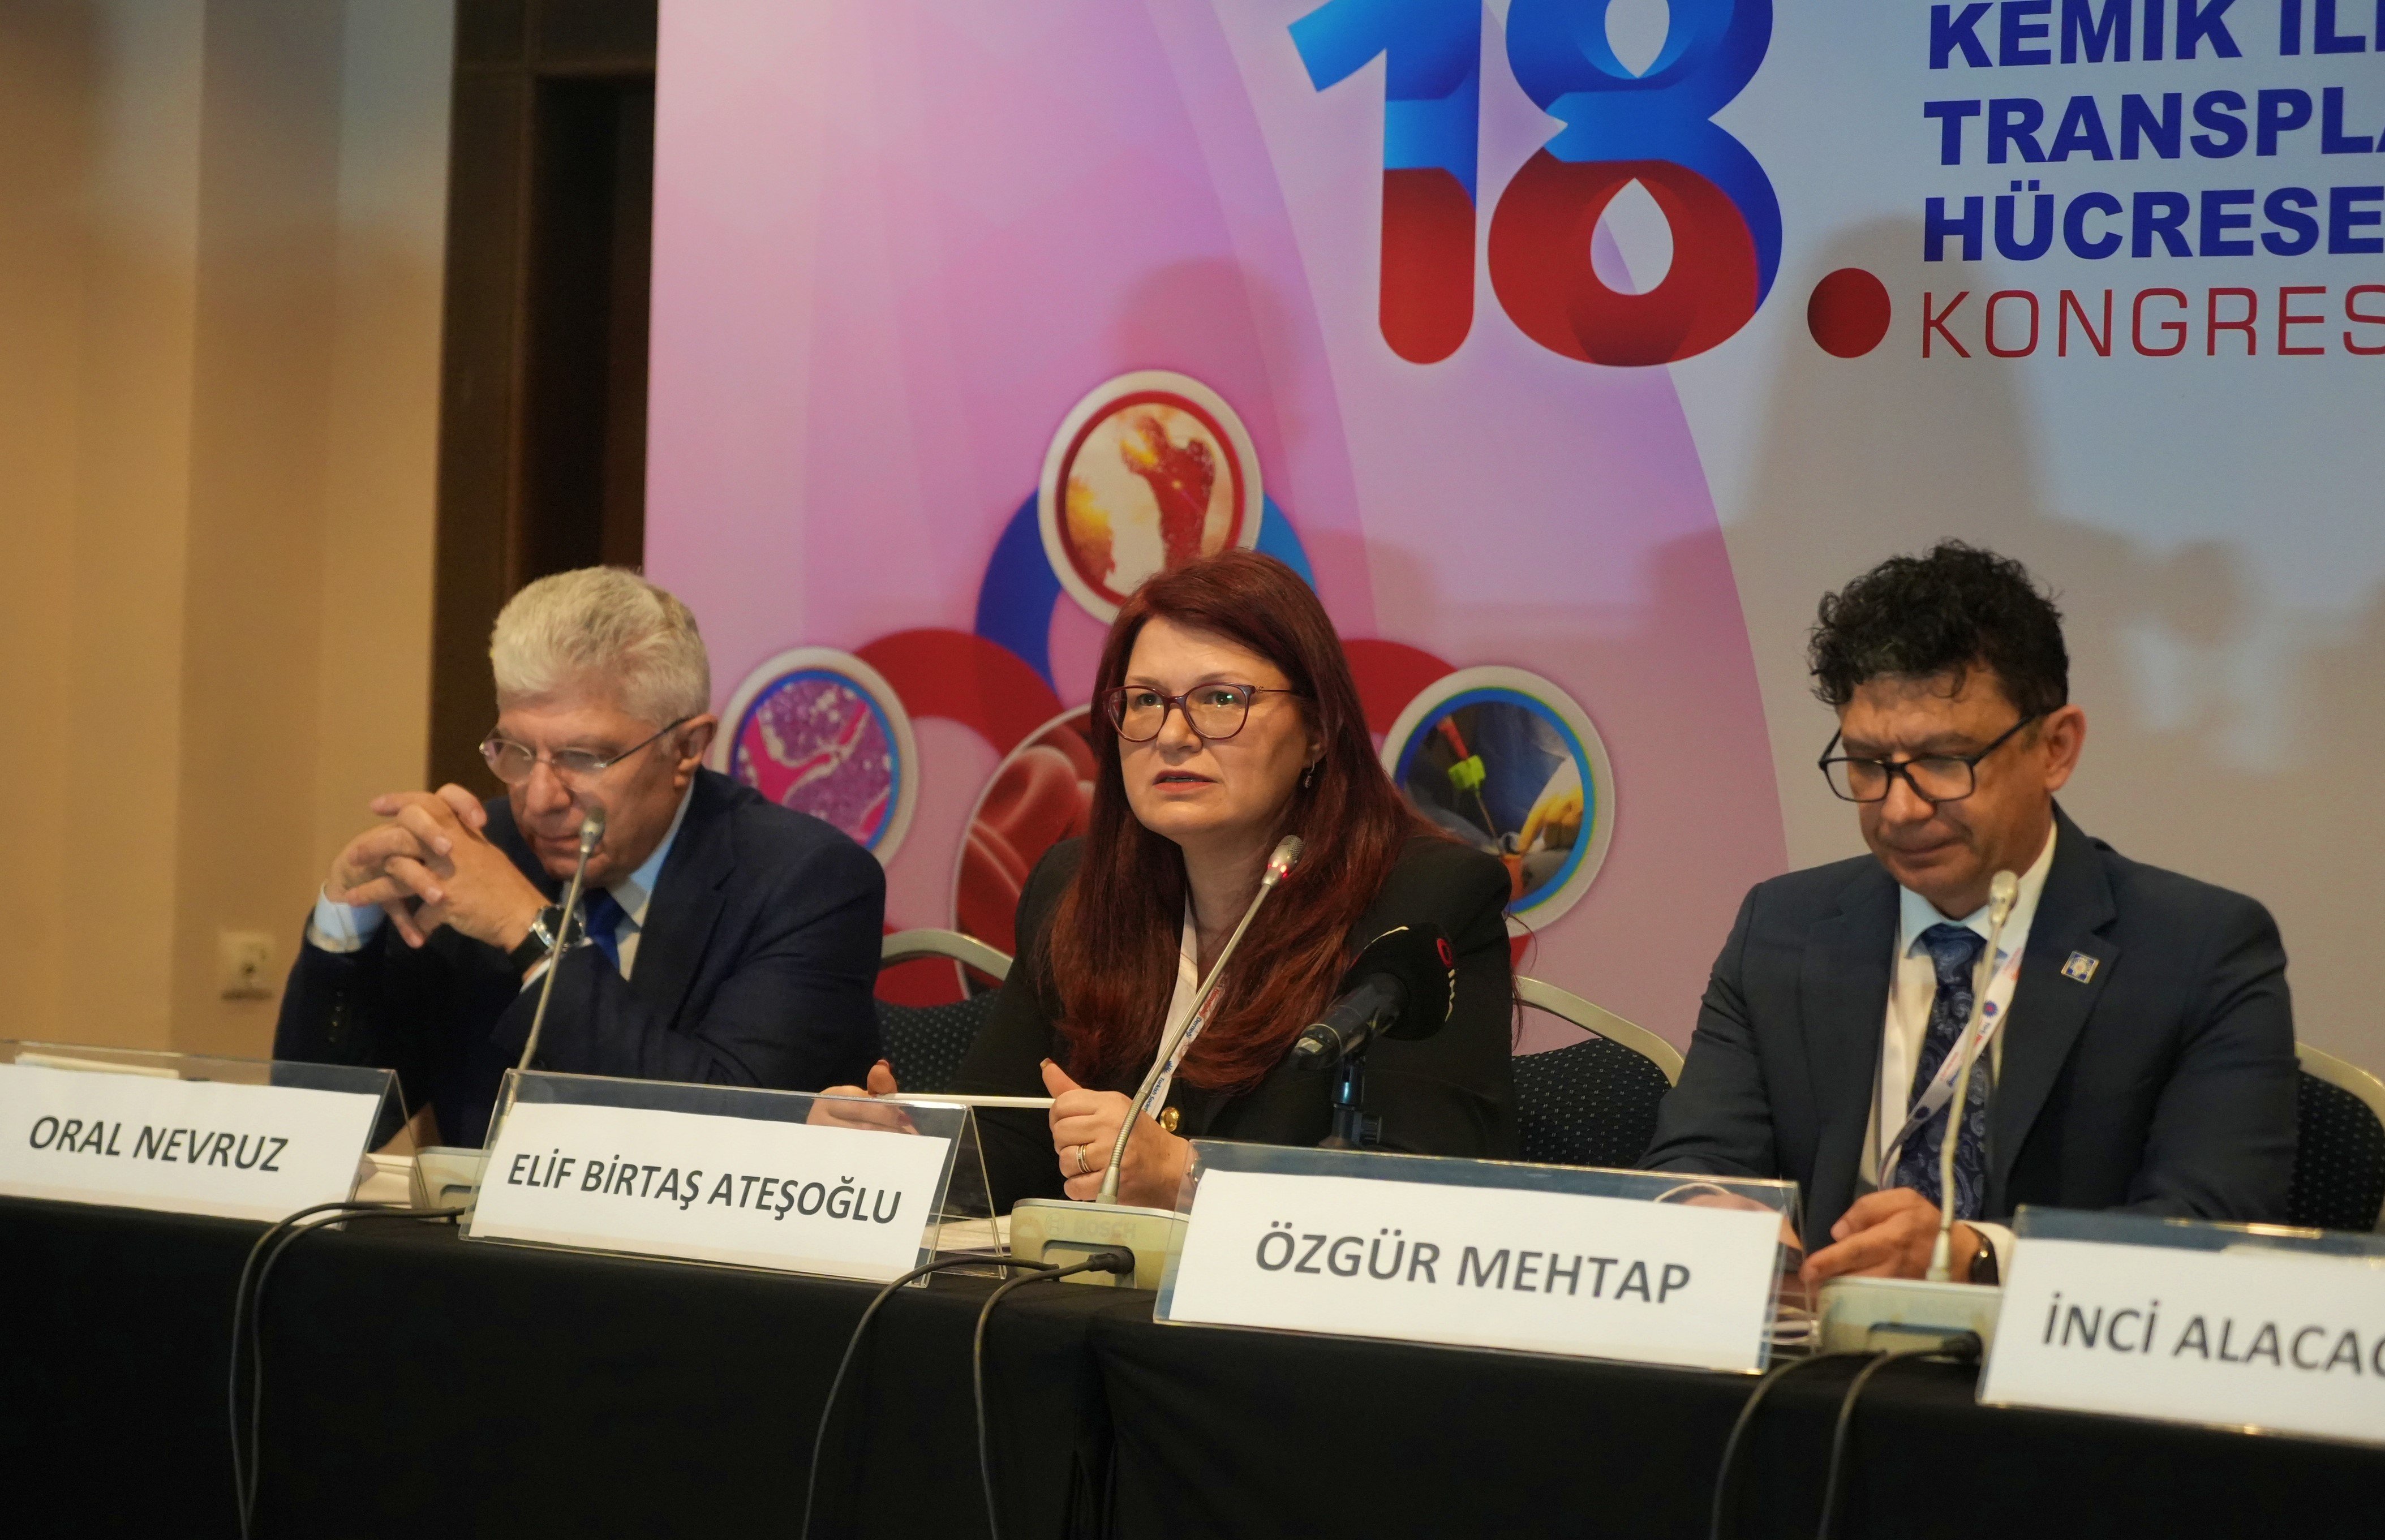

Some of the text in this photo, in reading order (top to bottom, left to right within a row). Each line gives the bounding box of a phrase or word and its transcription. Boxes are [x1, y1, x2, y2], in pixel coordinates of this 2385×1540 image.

[1924, 87, 2385, 165] TRANSPL
[1924, 179, 2384, 261] HÜCRESE
[1923, 285, 2385, 358] KONGRES
[1143, 1095, 1155, 1112] Societ
[29, 1116, 289, 1172] ORAL NEVRUZ
[508, 1148, 901, 1224] ELİF BİRTAŞ ATEŞOĞLU
[1256, 1221, 1690, 1304] ÖZGÜR MEHTAP
[2043, 1292, 2159, 1354] İNCİ
